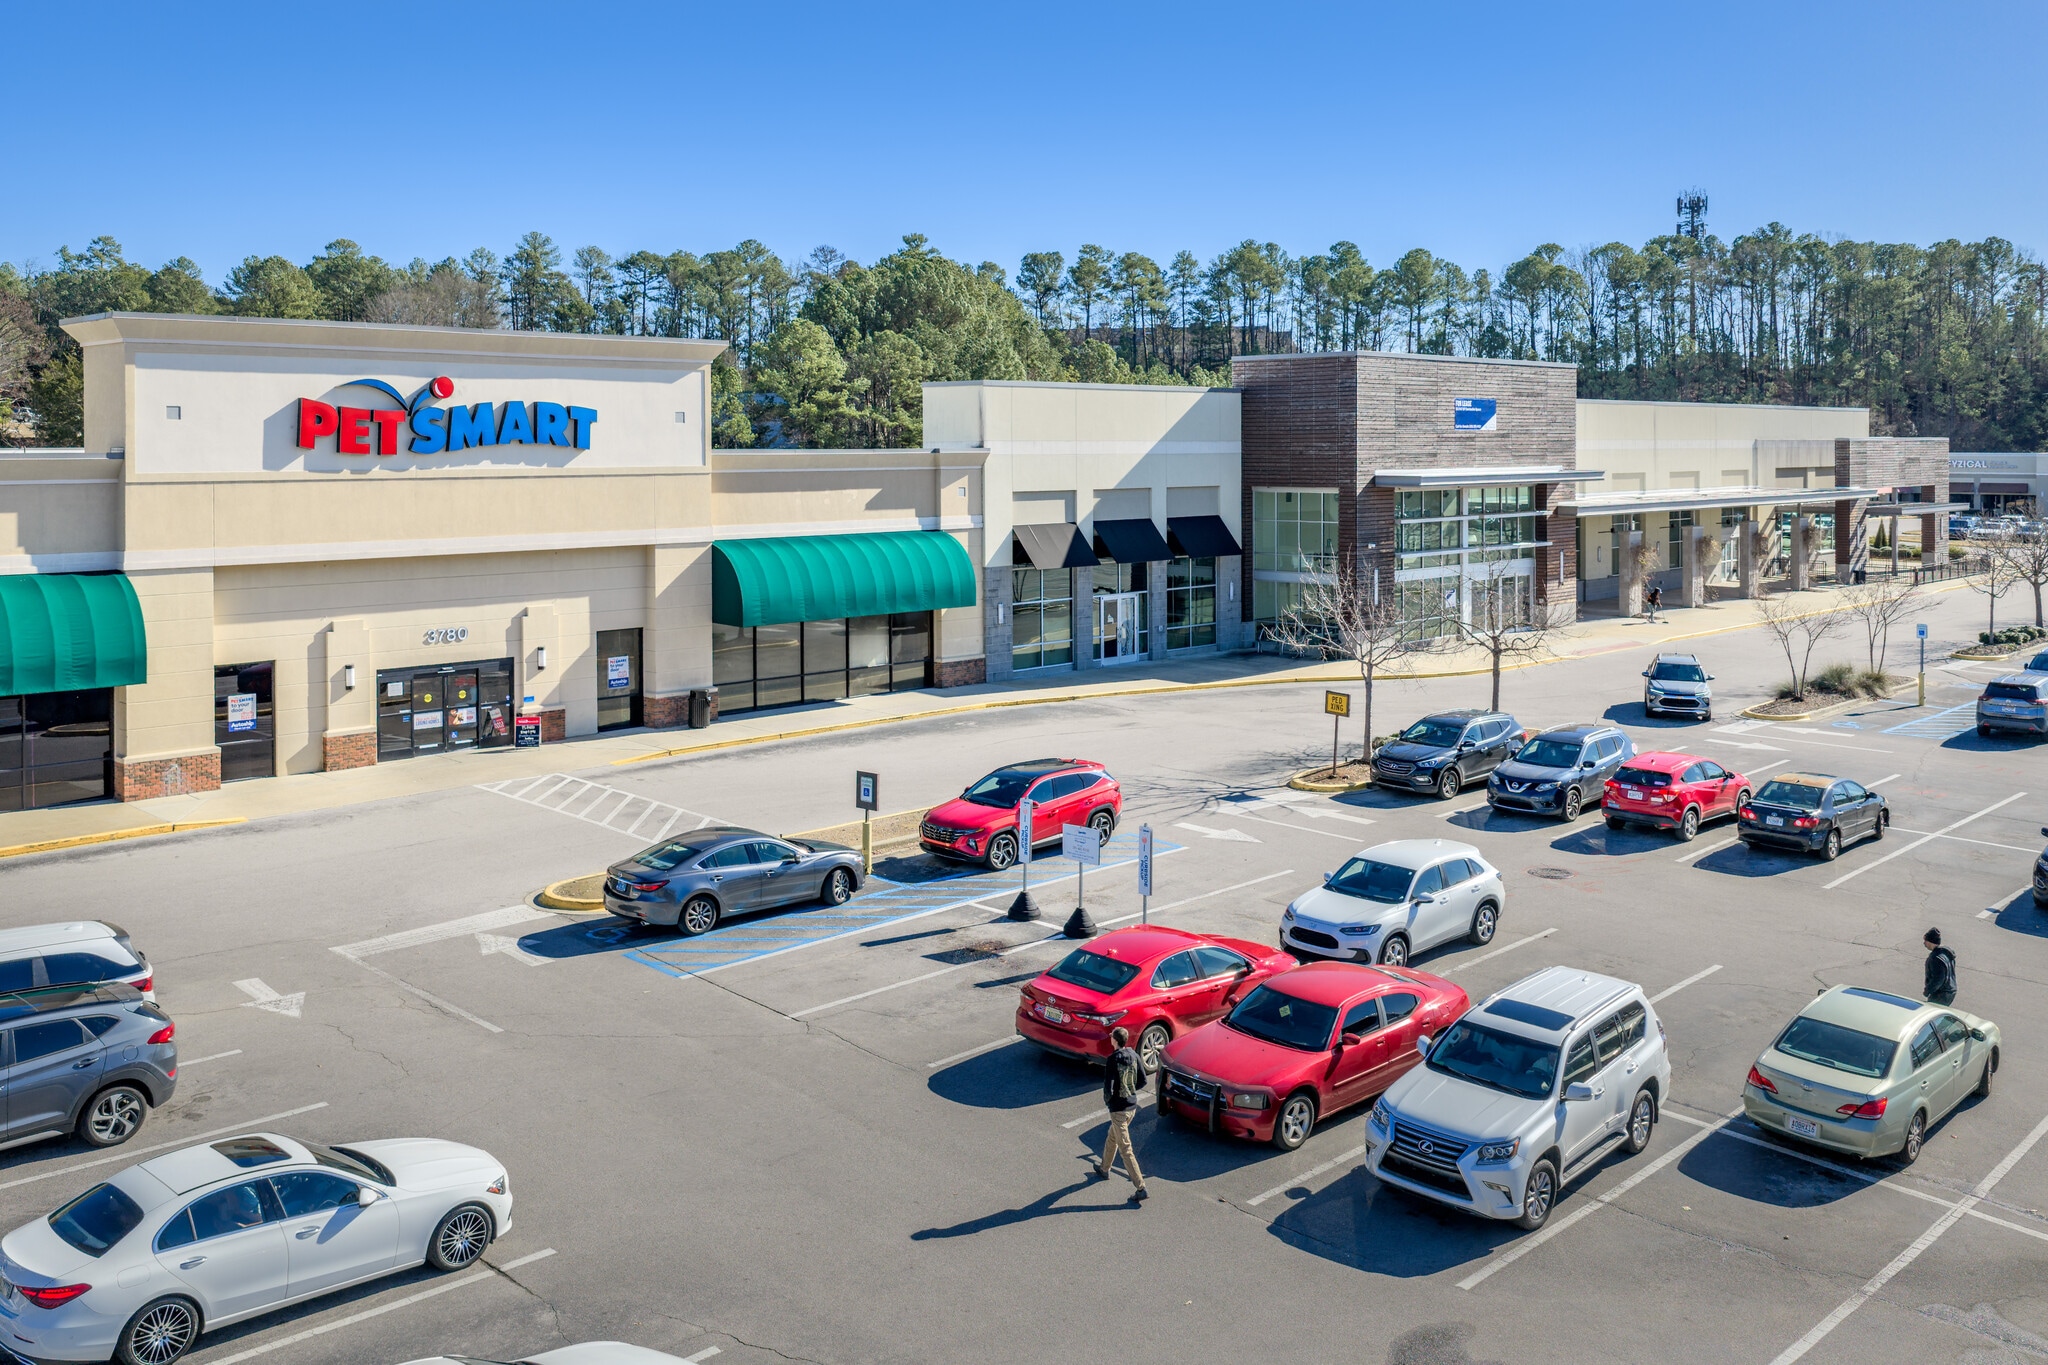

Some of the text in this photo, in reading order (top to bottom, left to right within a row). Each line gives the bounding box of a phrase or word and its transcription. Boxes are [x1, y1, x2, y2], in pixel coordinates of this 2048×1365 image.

[296, 396, 598, 455] PETSMART
[427, 627, 468, 643] 3780
[1332, 695, 1342, 704] PED
[1331, 702, 1344, 711] XING
[231, 720, 255, 728] Autoship
